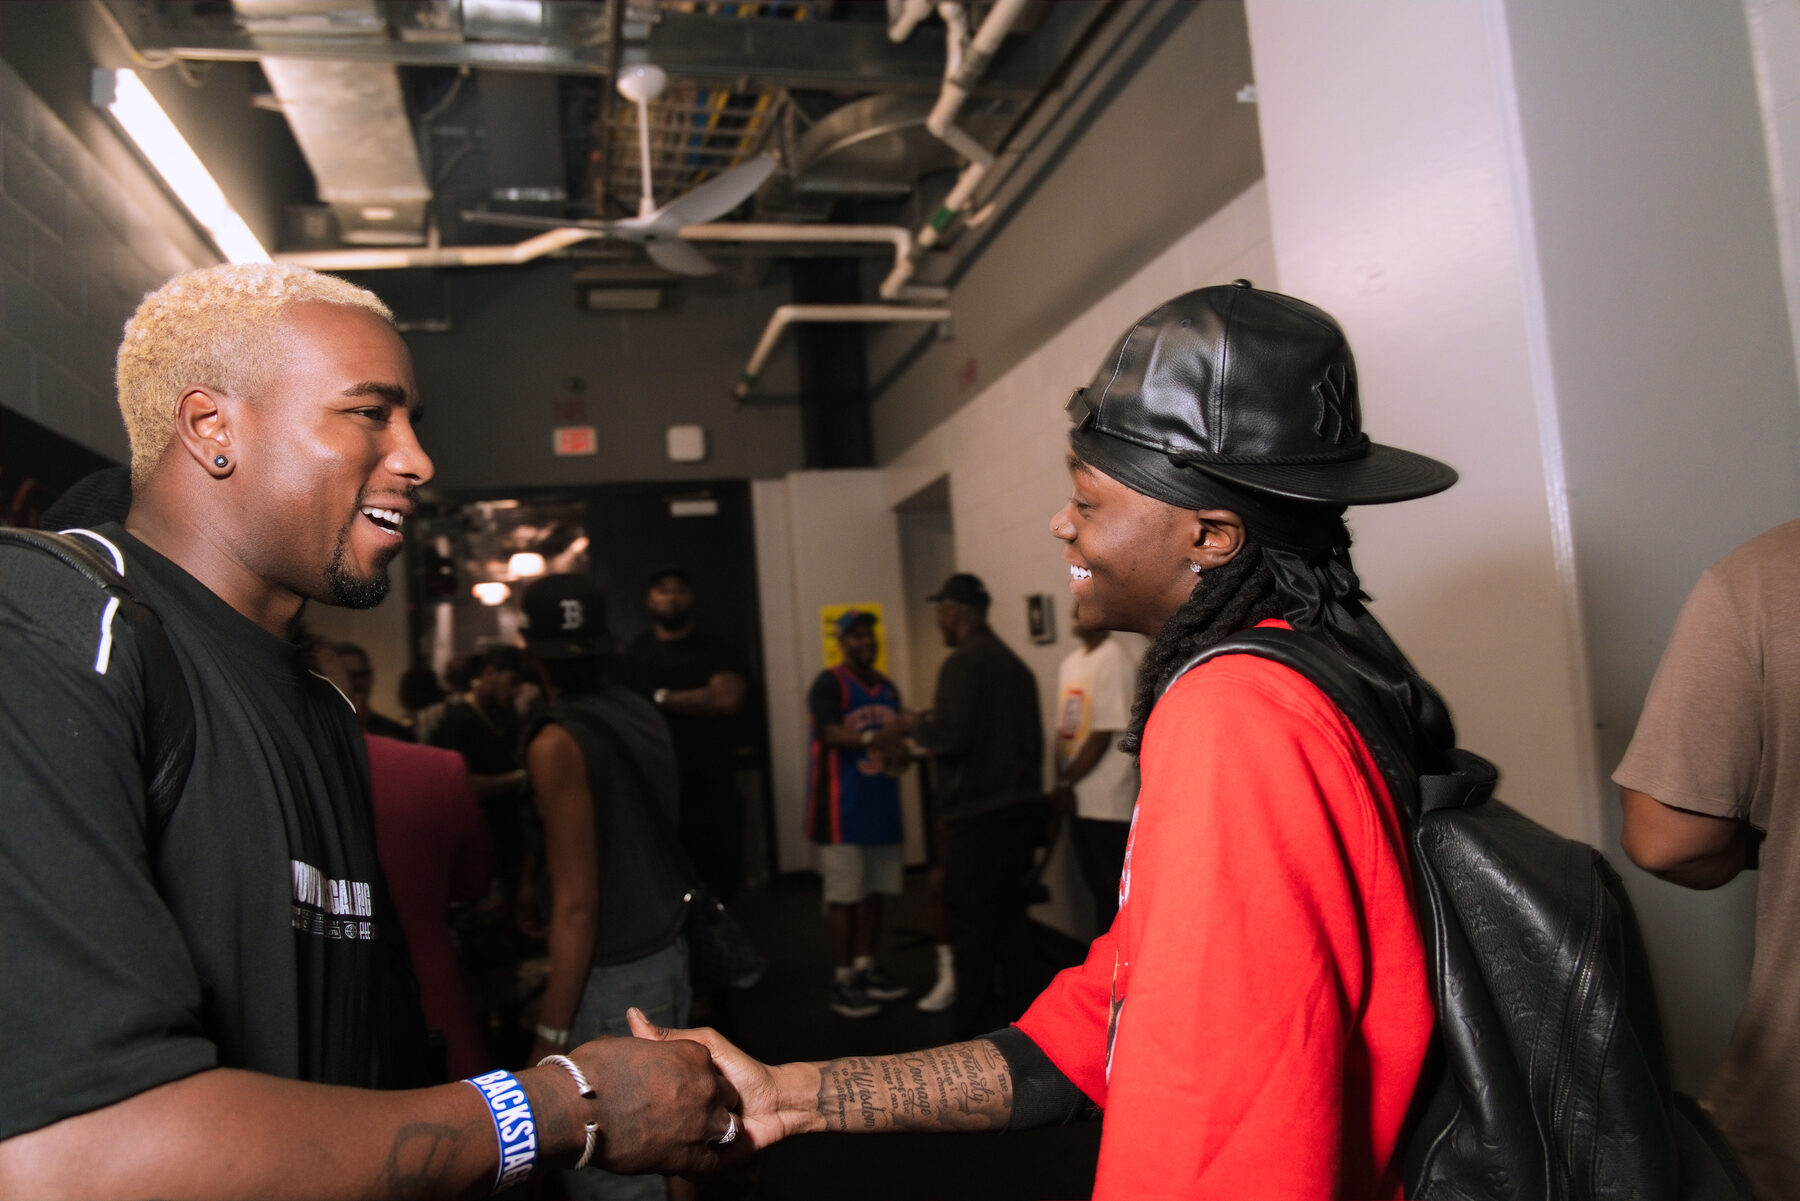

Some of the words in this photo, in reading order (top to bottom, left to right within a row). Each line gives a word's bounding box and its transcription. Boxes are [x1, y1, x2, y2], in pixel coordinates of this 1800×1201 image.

[559, 599, 584, 630] B
[851, 1070, 887, 1129] Wisdom
[895, 1067, 908, 1098] change
[904, 1057, 932, 1119] Courage
[471, 1070, 536, 1186] BACKSTAG
